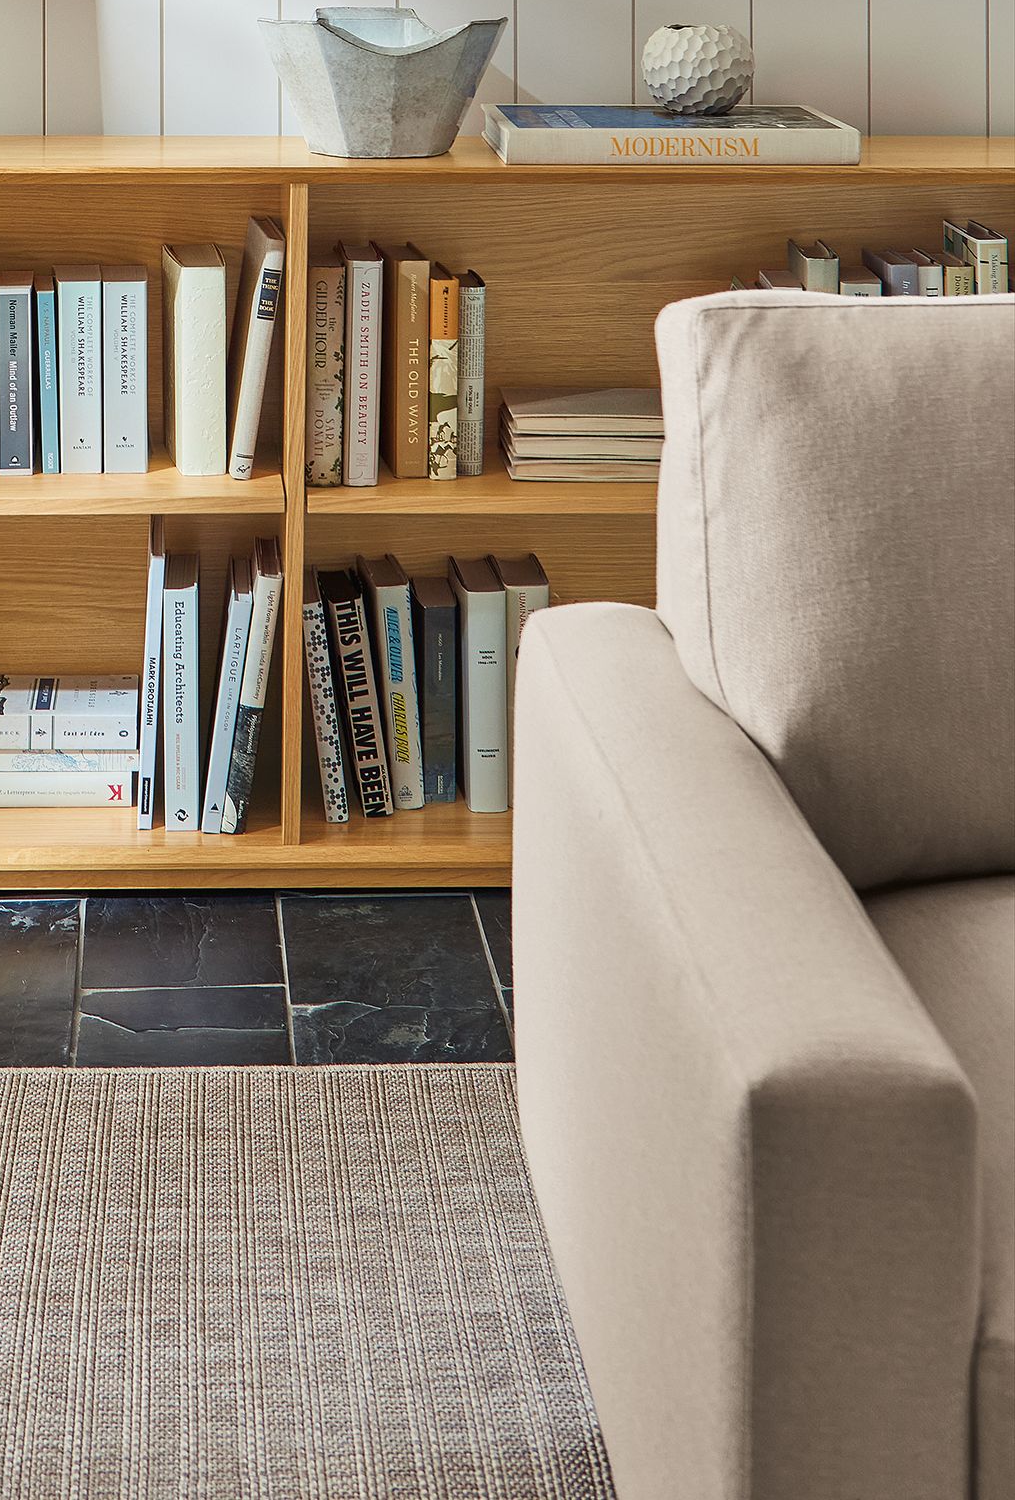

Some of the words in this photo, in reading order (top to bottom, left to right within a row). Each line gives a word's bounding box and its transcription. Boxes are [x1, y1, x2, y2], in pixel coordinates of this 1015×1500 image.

[610, 136, 760, 157] MODERNISM
[990, 254, 998, 278] Making
[262, 283, 279, 291] THING
[360, 282, 370, 321] ZADIE
[9, 300, 17, 329] Norman
[120, 294, 128, 332] WILLIAM
[315, 280, 328, 328] GILDED
[328, 317, 336, 332] the
[9, 331, 18, 357] Mailer
[314, 333, 327, 369] HOUR
[360, 326, 370, 368] SMITH
[408, 339, 419, 365] THE
[9, 360, 18, 380] Mind
[120, 336, 128, 395] SHAKESPEARE
[9, 381, 18, 390] of
[87, 387, 94, 397] OF
[129, 385, 136, 395] OF
[359, 373, 368, 390] ON
[408, 370, 419, 399] OLD
[9, 392, 16, 403] an
[9, 404, 18, 432] Outlaw
[358, 396, 368, 445] BEAUTY
[408, 404, 419, 444] WAYS
[313, 409, 324, 458] DONATI
[325, 418, 335, 448] SARA
[268, 590, 276, 606] Light
[266, 607, 274, 622] from
[335, 600, 361, 646] THIS
[386, 607, 400, 635] ALICE
[173, 601, 184, 658] Educating
[263, 623, 271, 645] within
[389, 636, 400, 645] &
[149, 657, 157, 680] MARK
[228, 628, 242, 682] LARTIGUE
[259, 650, 267, 668] Linda
[390, 645, 404, 684] OLIVER
[253, 669, 265, 700] McCartney
[343, 649, 370, 702] WILL
[146, 680, 156, 726] GROTJAHN
[174, 660, 185, 724] Architects
[226, 703, 231, 711] IN
[392, 692, 407, 736] CHARLES
[350, 706, 379, 762] HAVE
[397, 736, 410, 765] BOCK
[359, 765, 386, 818] BEEN
